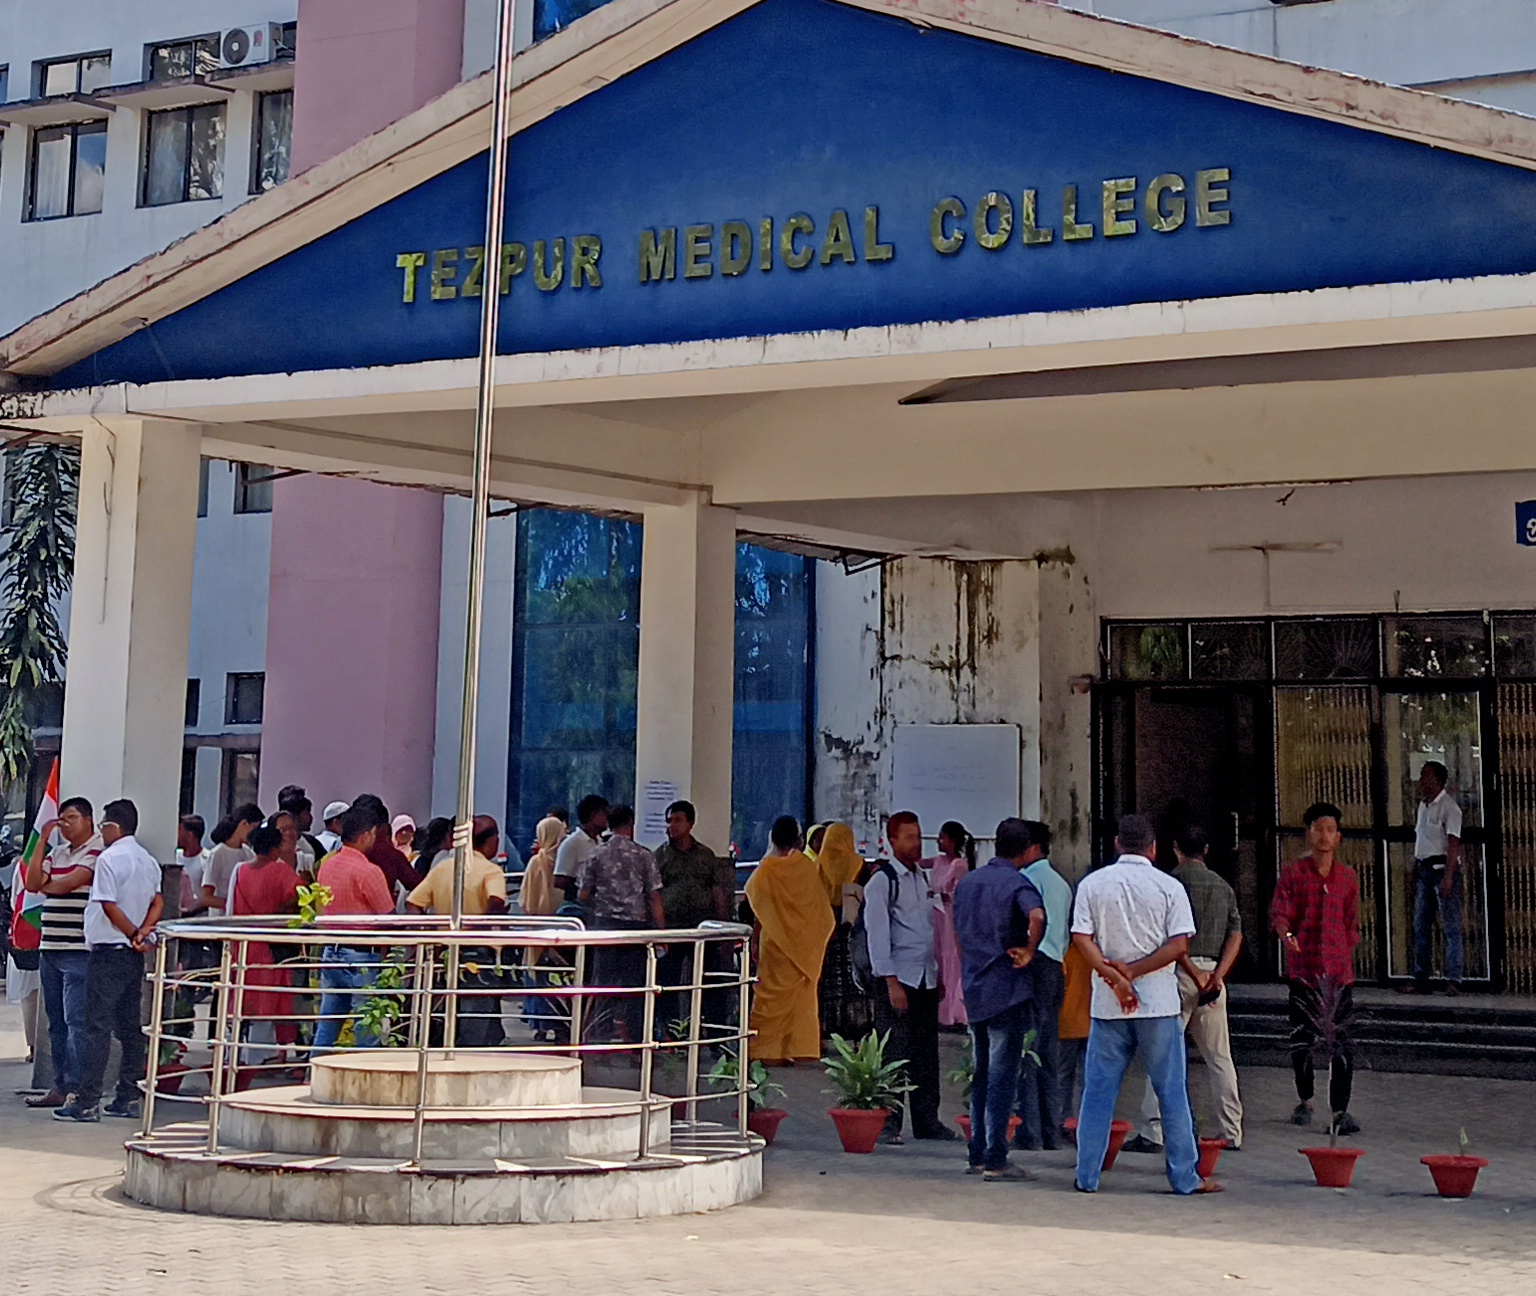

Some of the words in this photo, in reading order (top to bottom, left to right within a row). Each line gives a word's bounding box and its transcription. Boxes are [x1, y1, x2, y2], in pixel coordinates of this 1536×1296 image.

[395, 234, 604, 304] TEZPUR
[637, 205, 895, 284] MEDICAL
[929, 166, 1232, 254] COLLEGE
